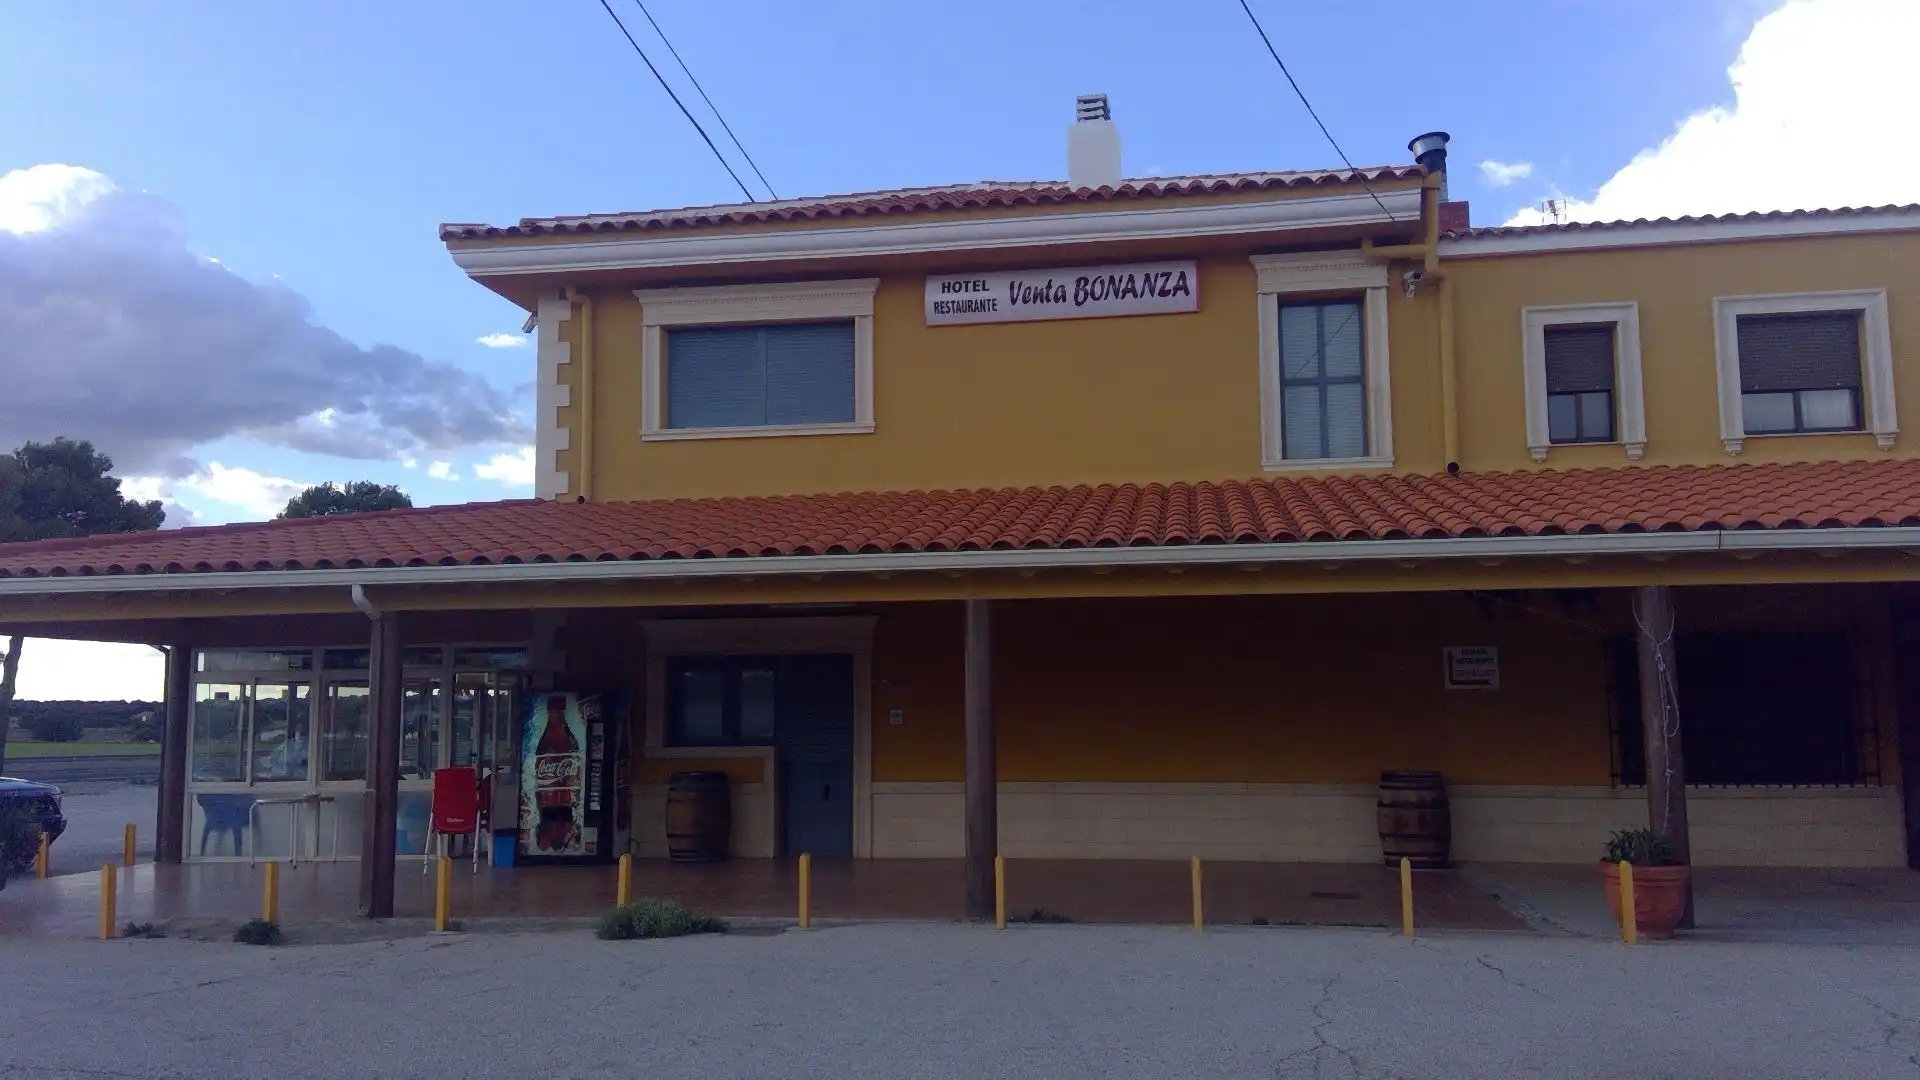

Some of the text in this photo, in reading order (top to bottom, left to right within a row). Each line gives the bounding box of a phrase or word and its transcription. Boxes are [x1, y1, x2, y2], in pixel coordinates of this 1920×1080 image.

[941, 280, 990, 293] HOTEL
[1009, 270, 1190, 306] Venta BONANZA
[933, 299, 998, 314] RESTAURANTE
